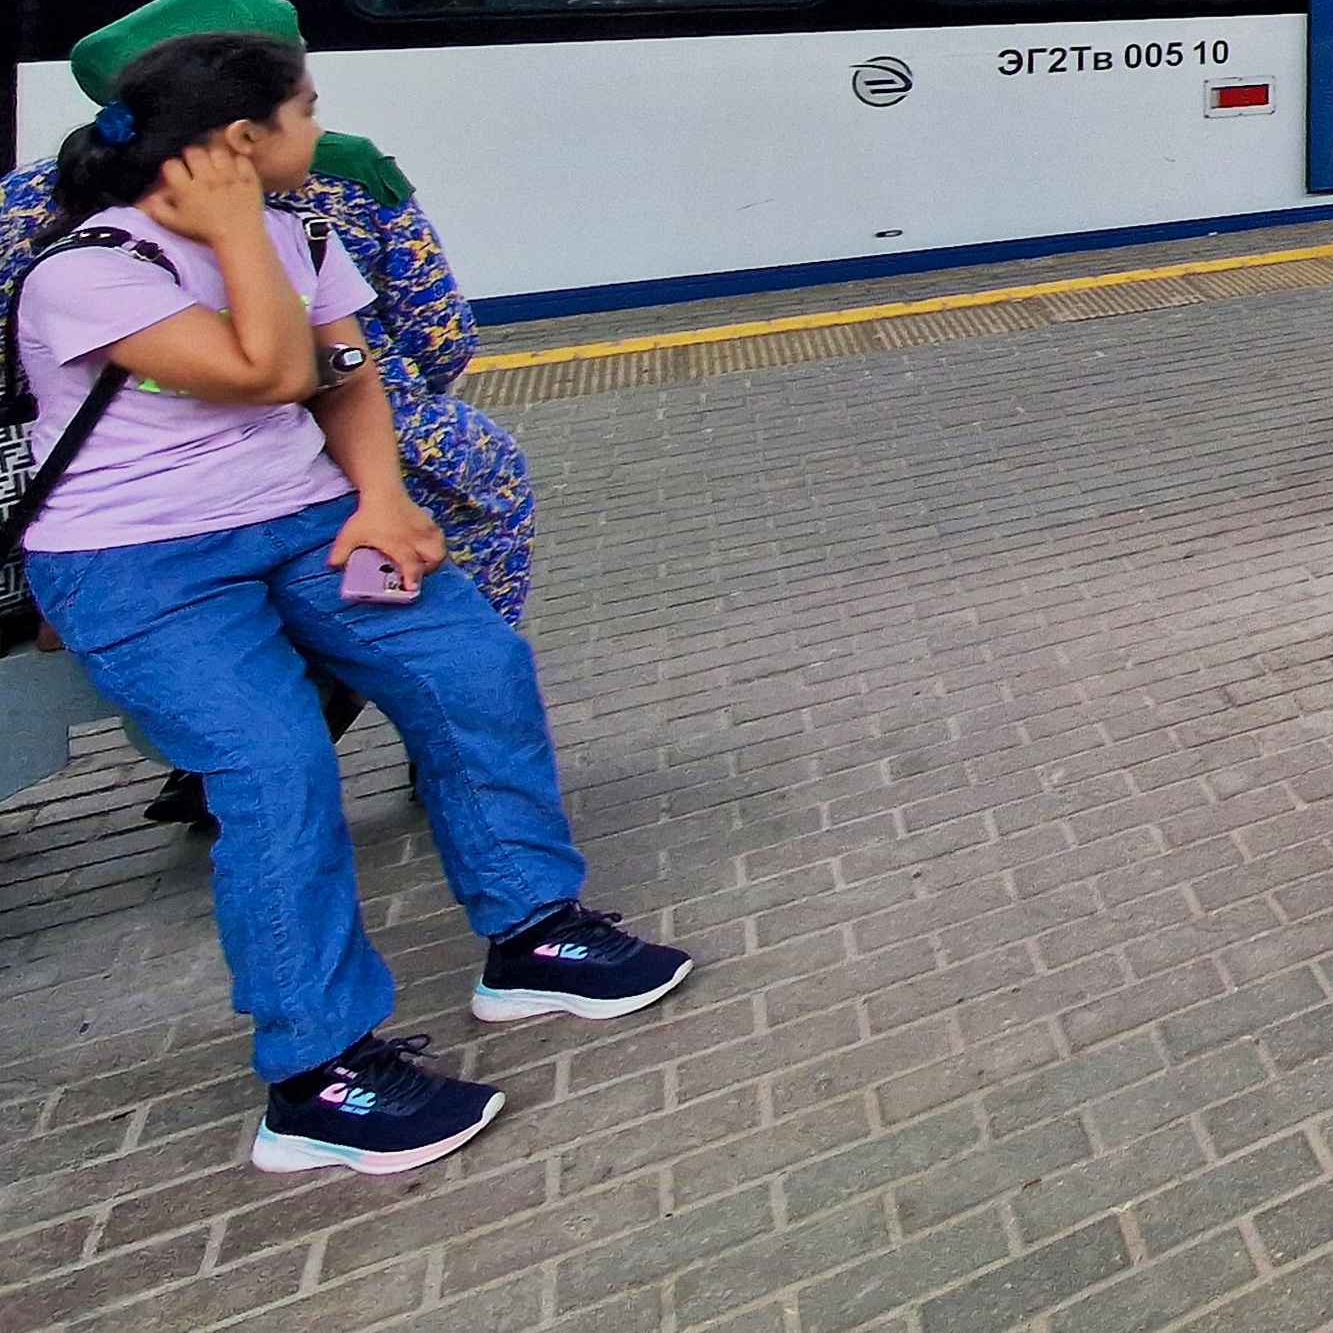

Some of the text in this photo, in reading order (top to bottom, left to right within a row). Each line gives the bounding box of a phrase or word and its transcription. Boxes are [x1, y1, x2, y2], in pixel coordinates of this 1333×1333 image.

[998, 40, 1230, 75] ЭГ2Тв 005 10
